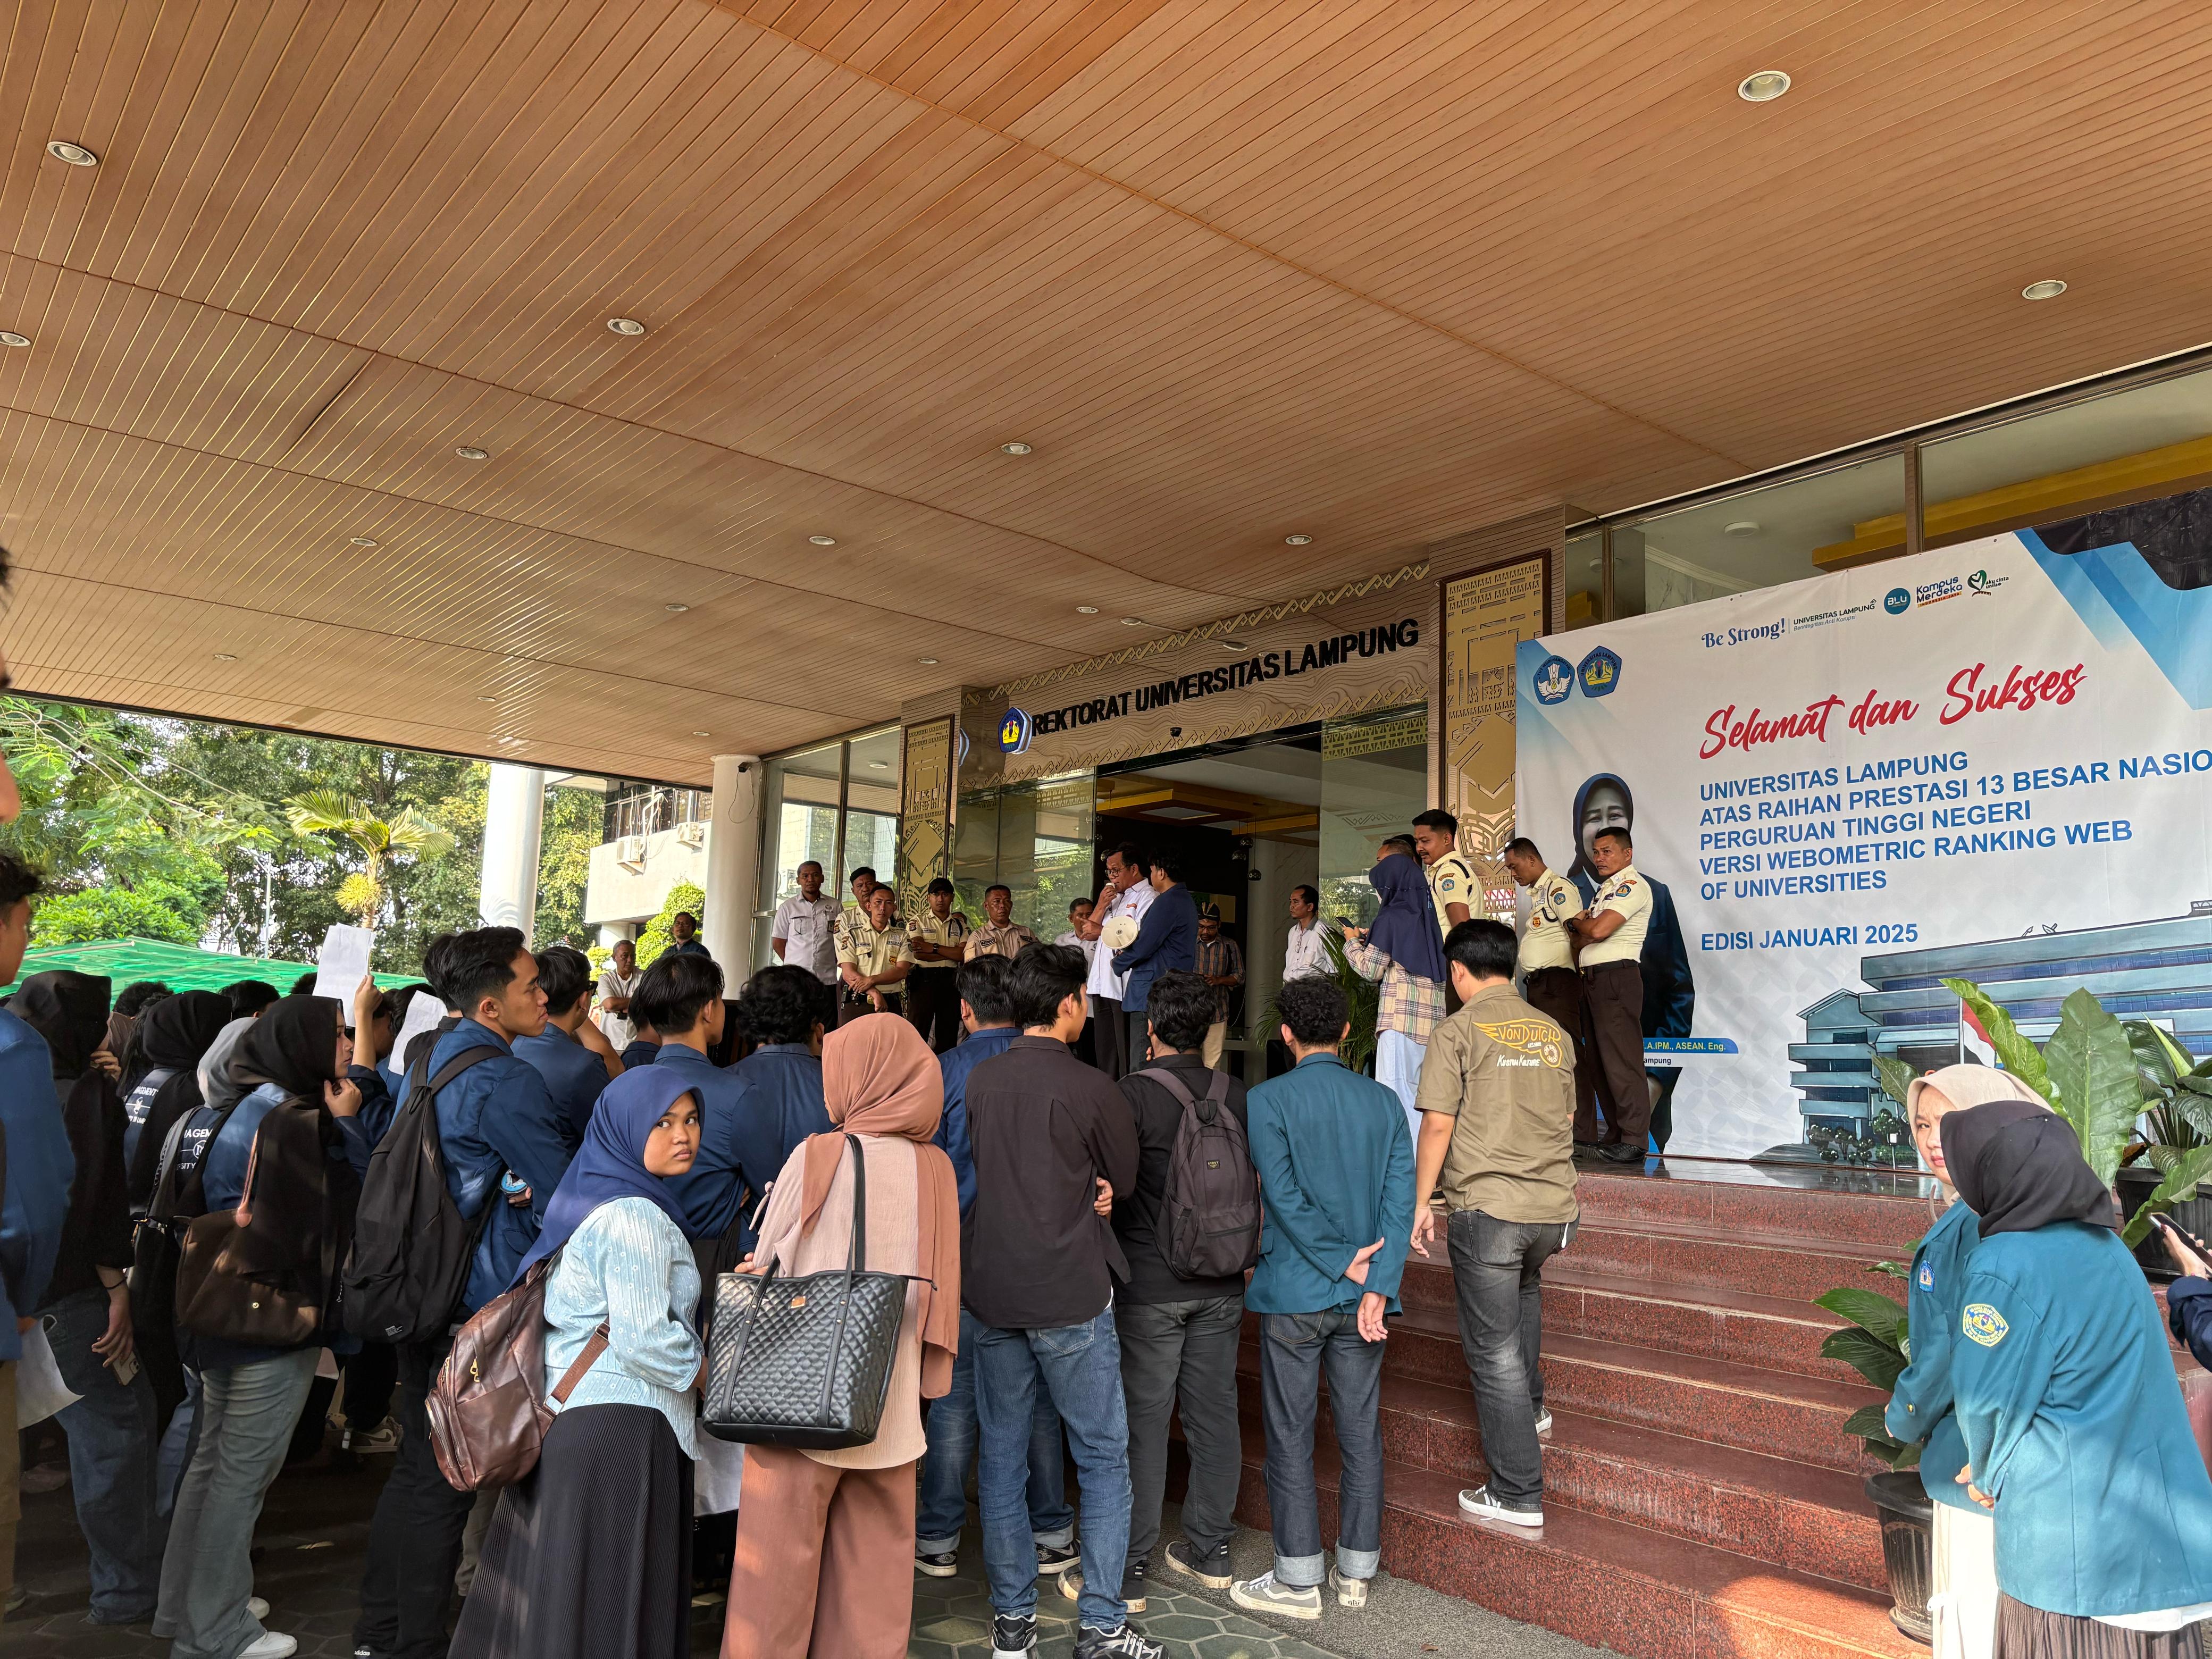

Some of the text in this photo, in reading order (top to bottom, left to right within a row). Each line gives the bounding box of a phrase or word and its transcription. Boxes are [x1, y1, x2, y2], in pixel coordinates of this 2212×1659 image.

[1916, 576, 1959, 594] Kampus
[1916, 583, 1963, 604] Merdeka
[1888, 595, 1907, 606] BLU
[1794, 604, 1875, 625] UNIVERSITAS LAMPUNG
[1836, 614, 1856, 623] Korupsi
[1701, 618, 1786, 648] Be Strong!
[1580, 652, 1618, 676] UNIVERSITAS LAMPUNG
[1032, 618, 1419, 738] REKTORAT UNIVERSITAS LAMPUNG
[1699, 663, 2086, 760] Selamat dan Sukses
[1700, 751, 1968, 801] UNIVERSITAS LAMPUNG
[1700, 749, 2212, 826] ATAS RAIHAN PRESTASI 13 BESAR NASIO
[1700, 799, 2031, 851] PERGURUAN TINGGI NEGERI
[1699, 819, 2133, 876] VERSI WEBOMETRIC RANKING WEB
[1700, 869, 1887, 901] OF UNIVERSITIES
[1701, 923, 1918, 951] EDISI JANUARI 2025
[1497, 1024, 1557, 1043] VON DUTCH
[1675, 1041, 1706, 1050] ASEAN.
[1708, 1042, 1726, 1052] Eng.
[1644, 1057, 1672, 1066] ampung
